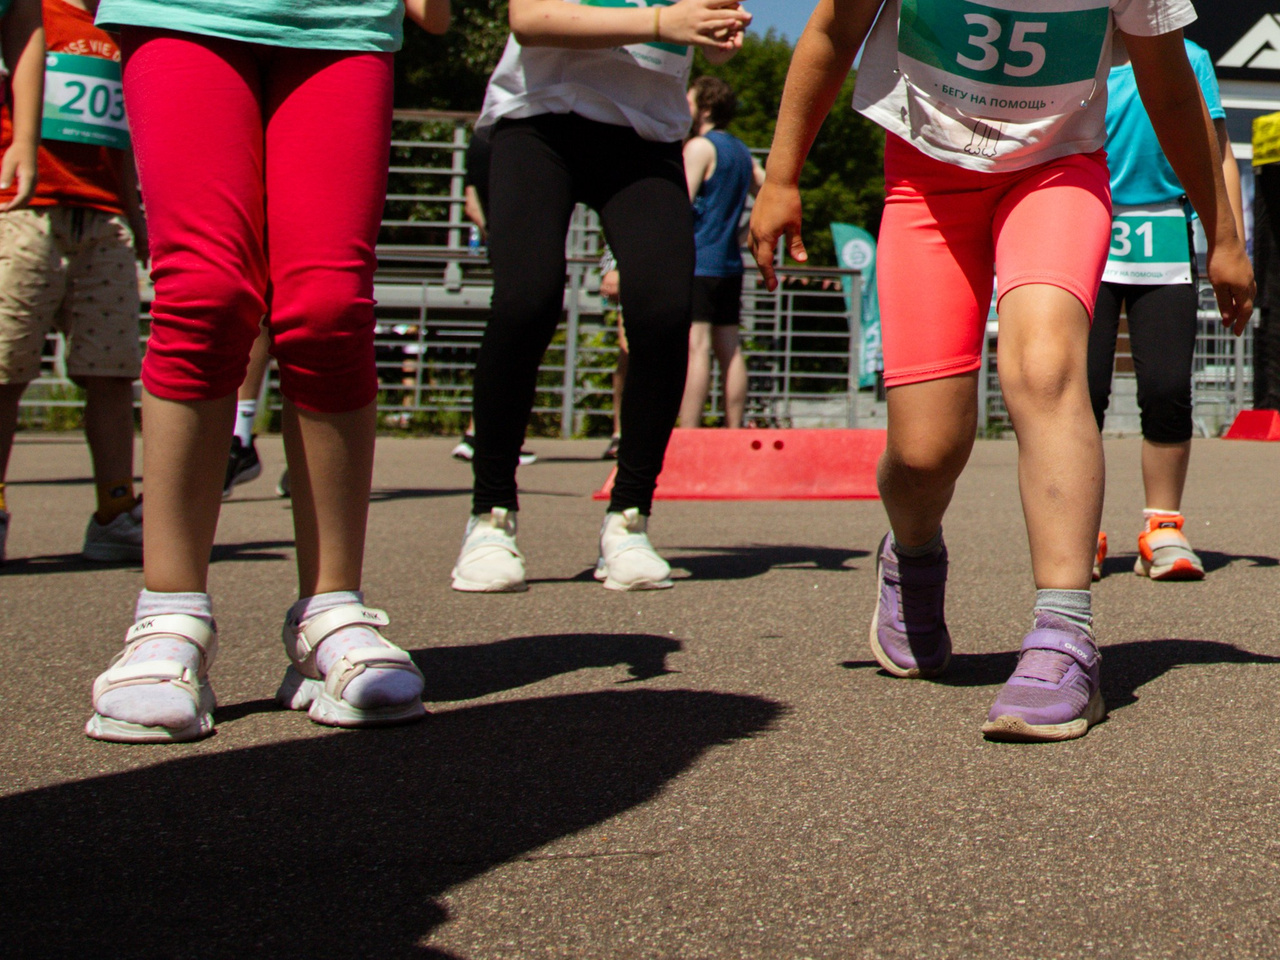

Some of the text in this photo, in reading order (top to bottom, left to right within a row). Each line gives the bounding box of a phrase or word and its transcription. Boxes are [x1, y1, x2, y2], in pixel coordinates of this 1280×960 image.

[956, 12, 1047, 78] 35
[58, 80, 125, 122] 203
[941, 84, 1047, 110] БЕГУ НА ПОМОЩЬ
[1109, 221, 1153, 257] 31
[1064, 642, 1089, 659] GEOX
